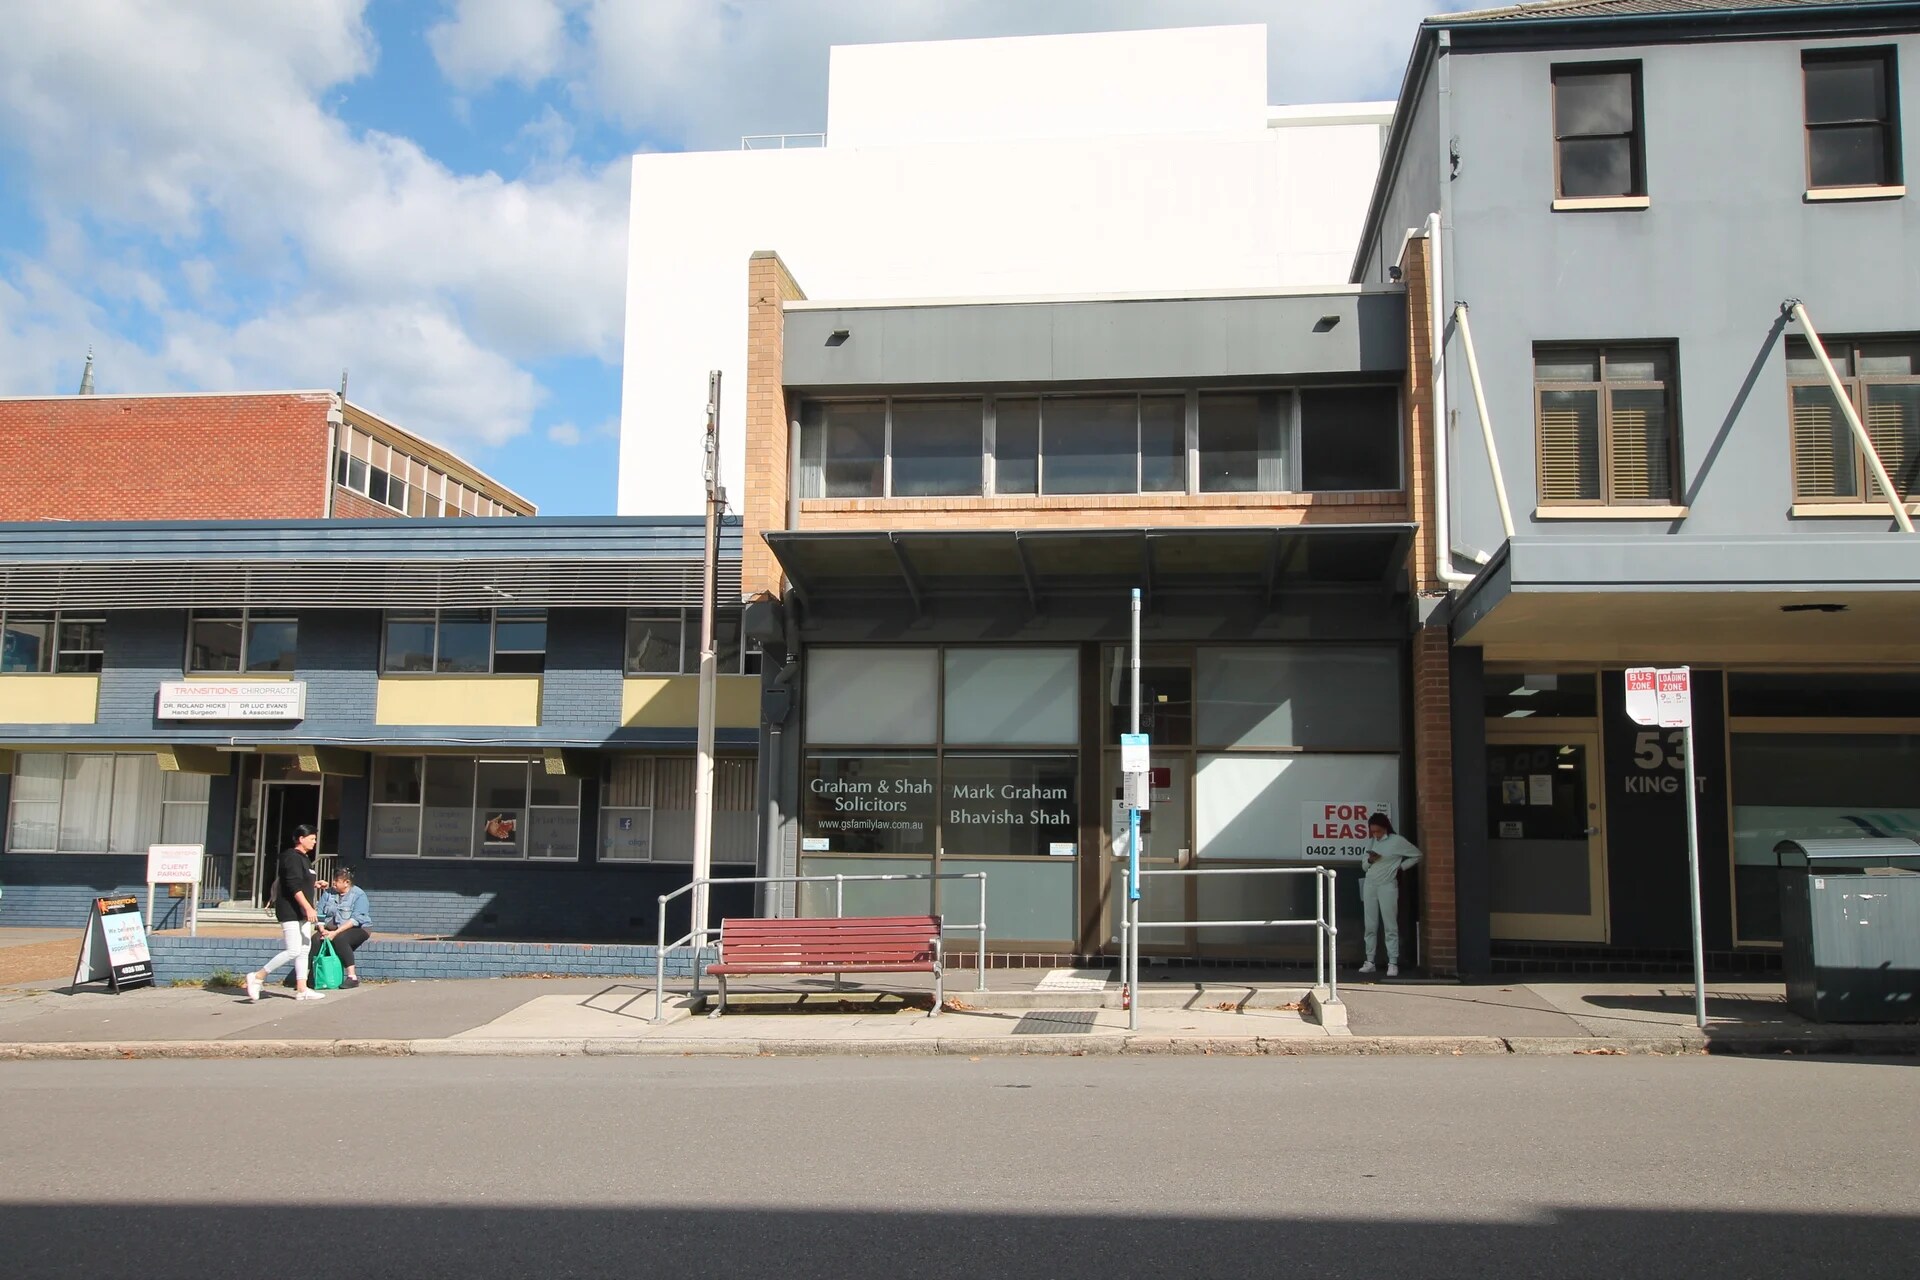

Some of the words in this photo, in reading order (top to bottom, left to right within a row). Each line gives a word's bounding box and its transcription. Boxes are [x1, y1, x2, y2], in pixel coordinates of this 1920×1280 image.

[1629, 672, 1652, 681] BUS
[1659, 673, 1686, 682] LOADING
[174, 687, 239, 695] TRANSITIONS
[241, 687, 298, 695] CHIROPRACTIC
[1631, 681, 1652, 690] ZONE
[1662, 682, 1684, 691] ZONE
[1633, 731, 1686, 770] 53
[810, 778, 872, 794] Graham
[877, 779, 891, 794] &
[894, 778, 933, 794] Shah
[953, 783, 995, 799] Mark
[1001, 784, 1068, 799] Graham
[1624, 776, 1679, 793] KING
[835, 796, 907, 812] Solicitors
[950, 809, 1024, 824] Bhavisha
[1030, 809, 1071, 825] Shah
[1324, 804, 1368, 821] FOR
[818, 818, 923, 831] www.gsfamilylaw.com.au
[1306, 845, 1336, 856] 0402
